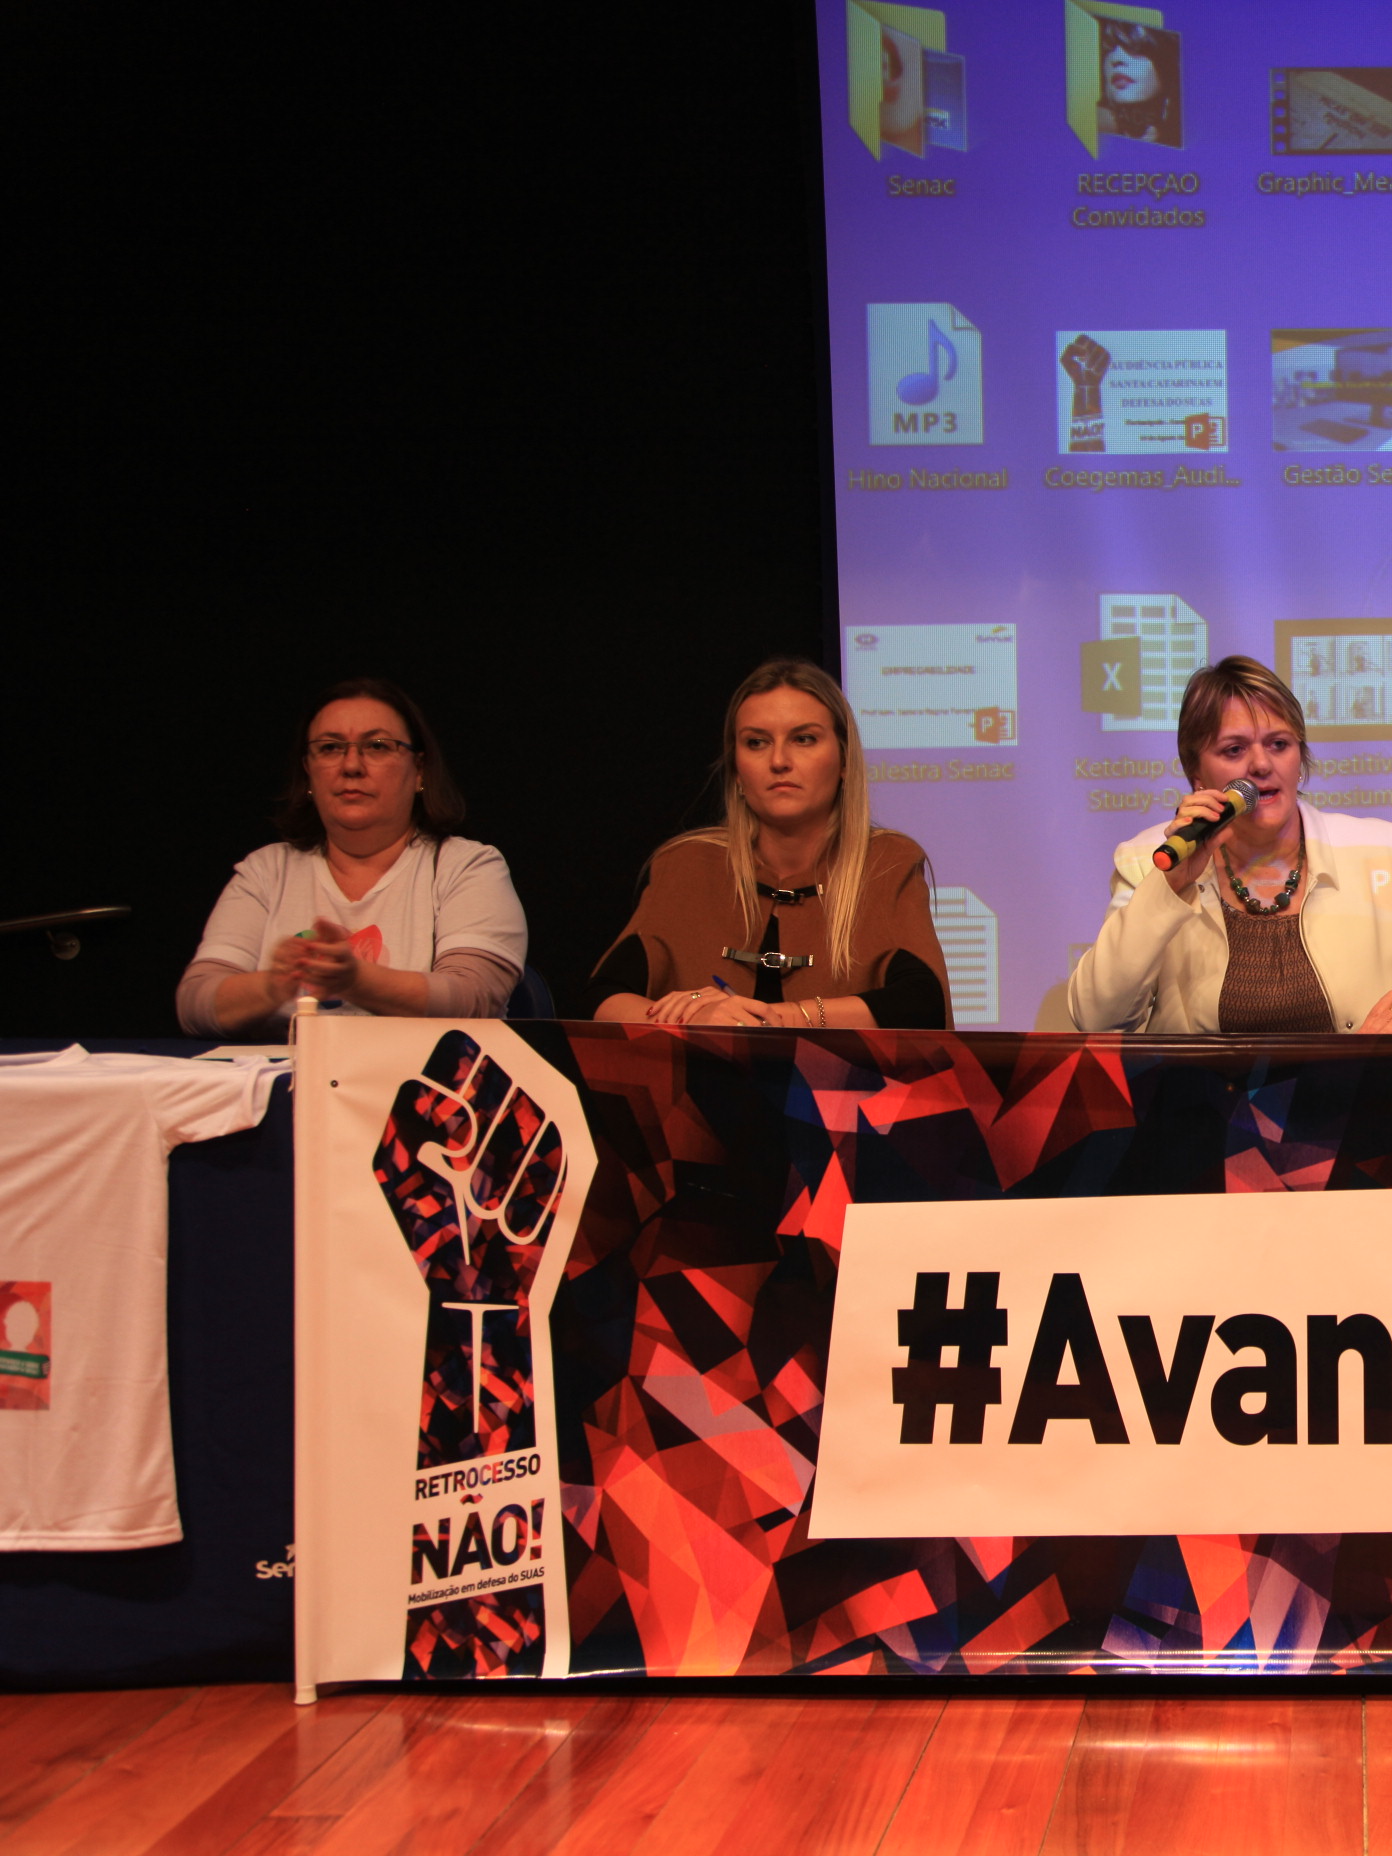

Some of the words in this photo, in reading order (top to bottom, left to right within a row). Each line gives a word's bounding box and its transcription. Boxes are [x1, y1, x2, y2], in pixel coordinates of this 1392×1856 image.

[888, 174, 956, 197] Senac
[1072, 206, 1206, 229] Convidados
[893, 412, 958, 434] MP3
[848, 469, 901, 491] Hino
[909, 468, 1009, 491] Nacional
[1283, 463, 1361, 486] Gestão
[1102, 662, 1123, 692] X
[868, 761, 942, 781] alestra
[948, 759, 1015, 780] Senac
[1074, 756, 1165, 781] Ketchup
[1089, 788, 1182, 814] Study-D
[415, 1453, 541, 1501] RETROCESSO
[411, 1493, 546, 1585] NÃO!
[408, 1585, 460, 1605] Mobilização
[461, 1583, 475, 1594] em
[477, 1573, 507, 1590] defesa
[508, 1571, 519, 1584] do
[520, 1566, 545, 1582] SUAS
